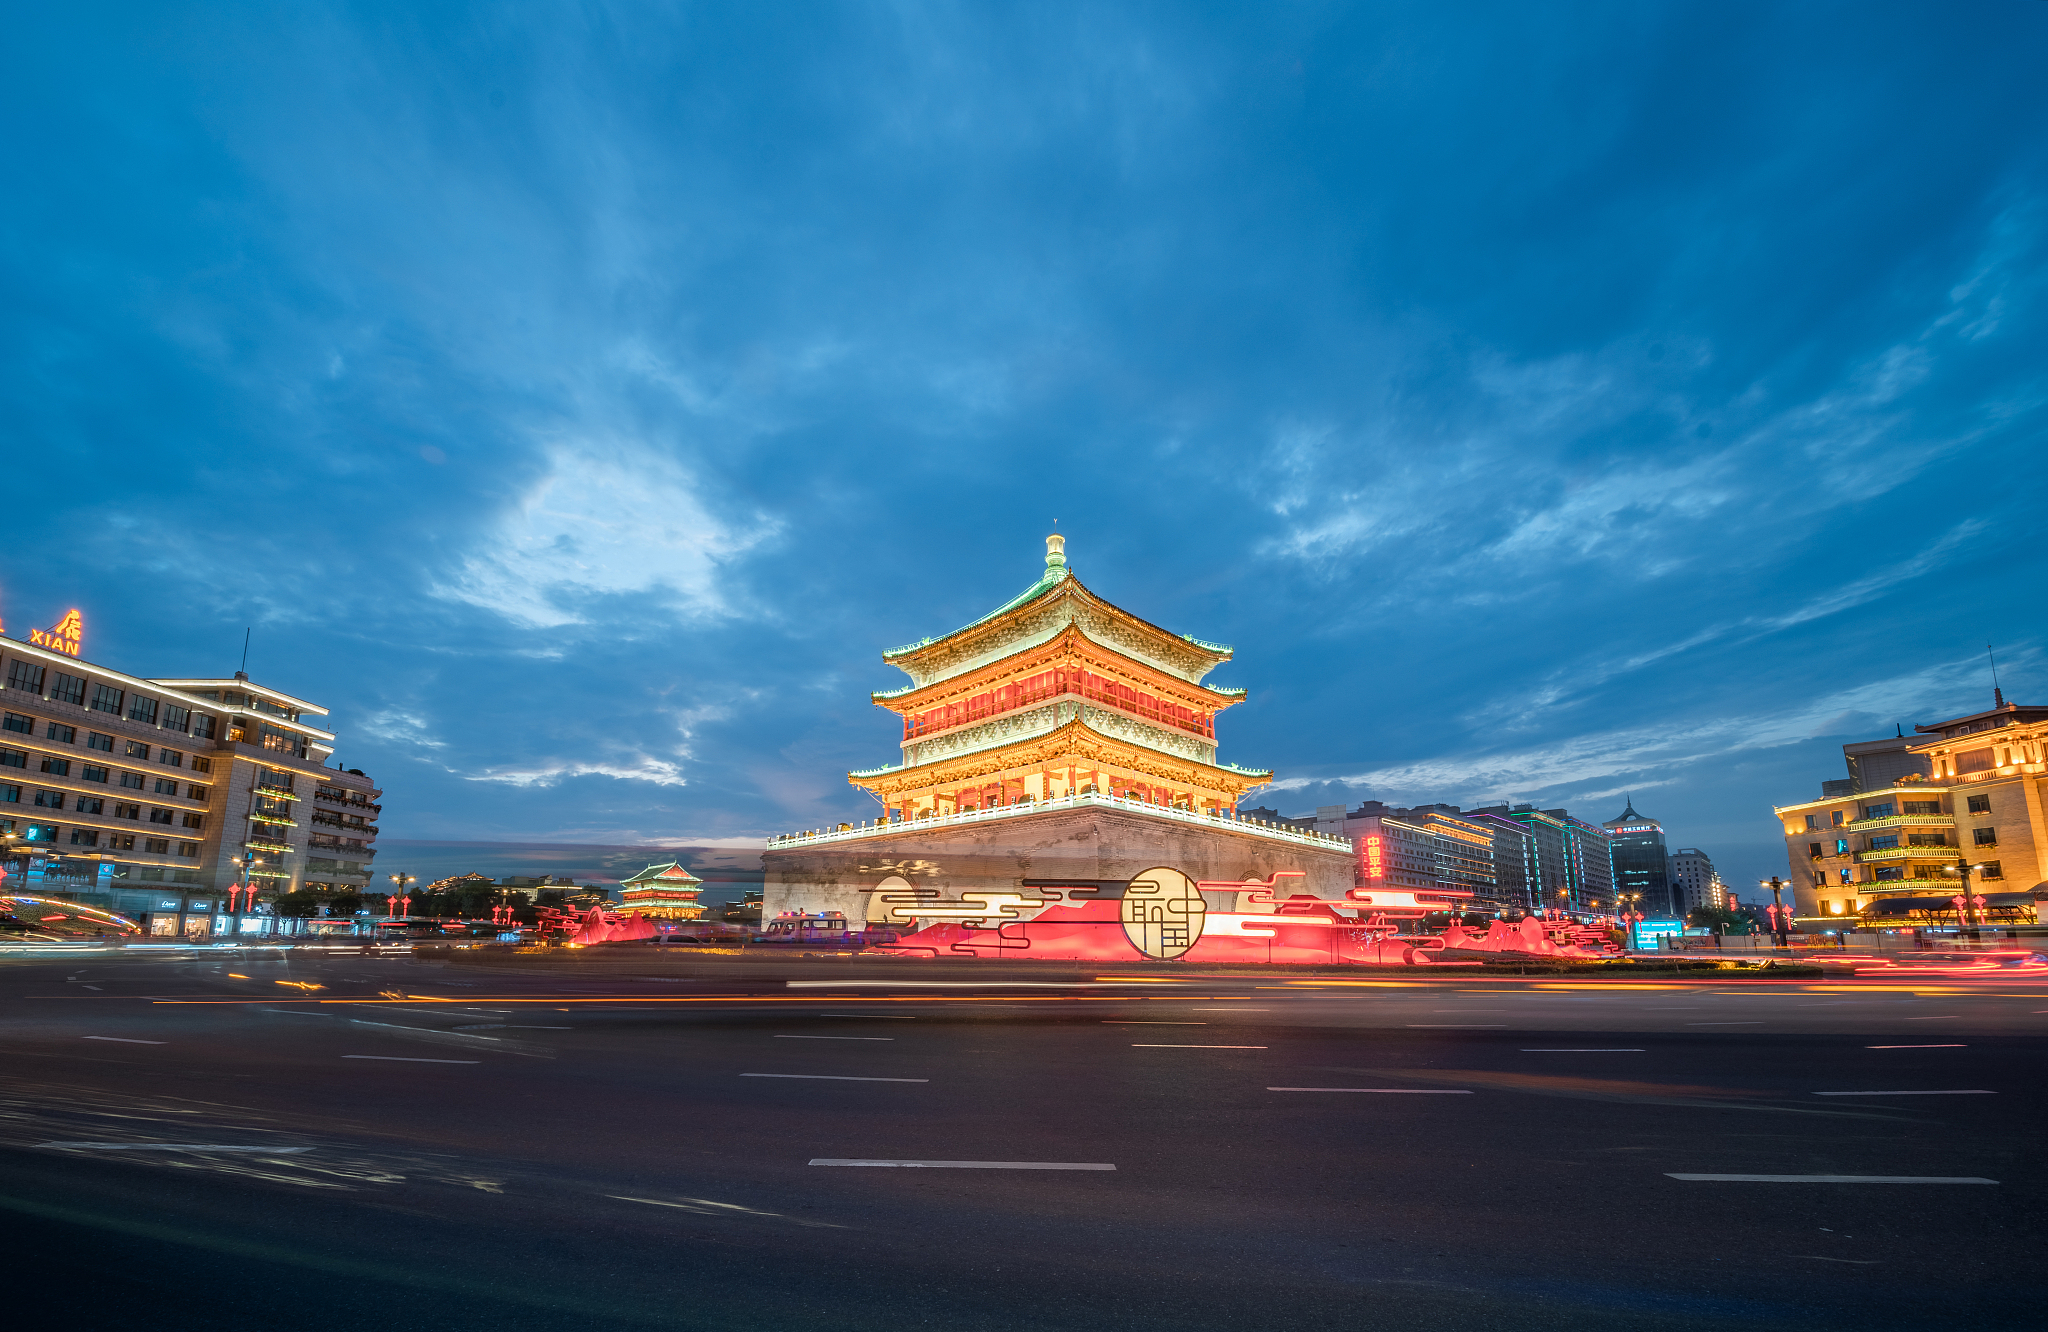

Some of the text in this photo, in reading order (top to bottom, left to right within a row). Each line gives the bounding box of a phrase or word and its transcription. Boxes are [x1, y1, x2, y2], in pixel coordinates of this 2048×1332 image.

[30, 628, 80, 656] XIAN
[1367, 836, 1382, 878] 中国平安
